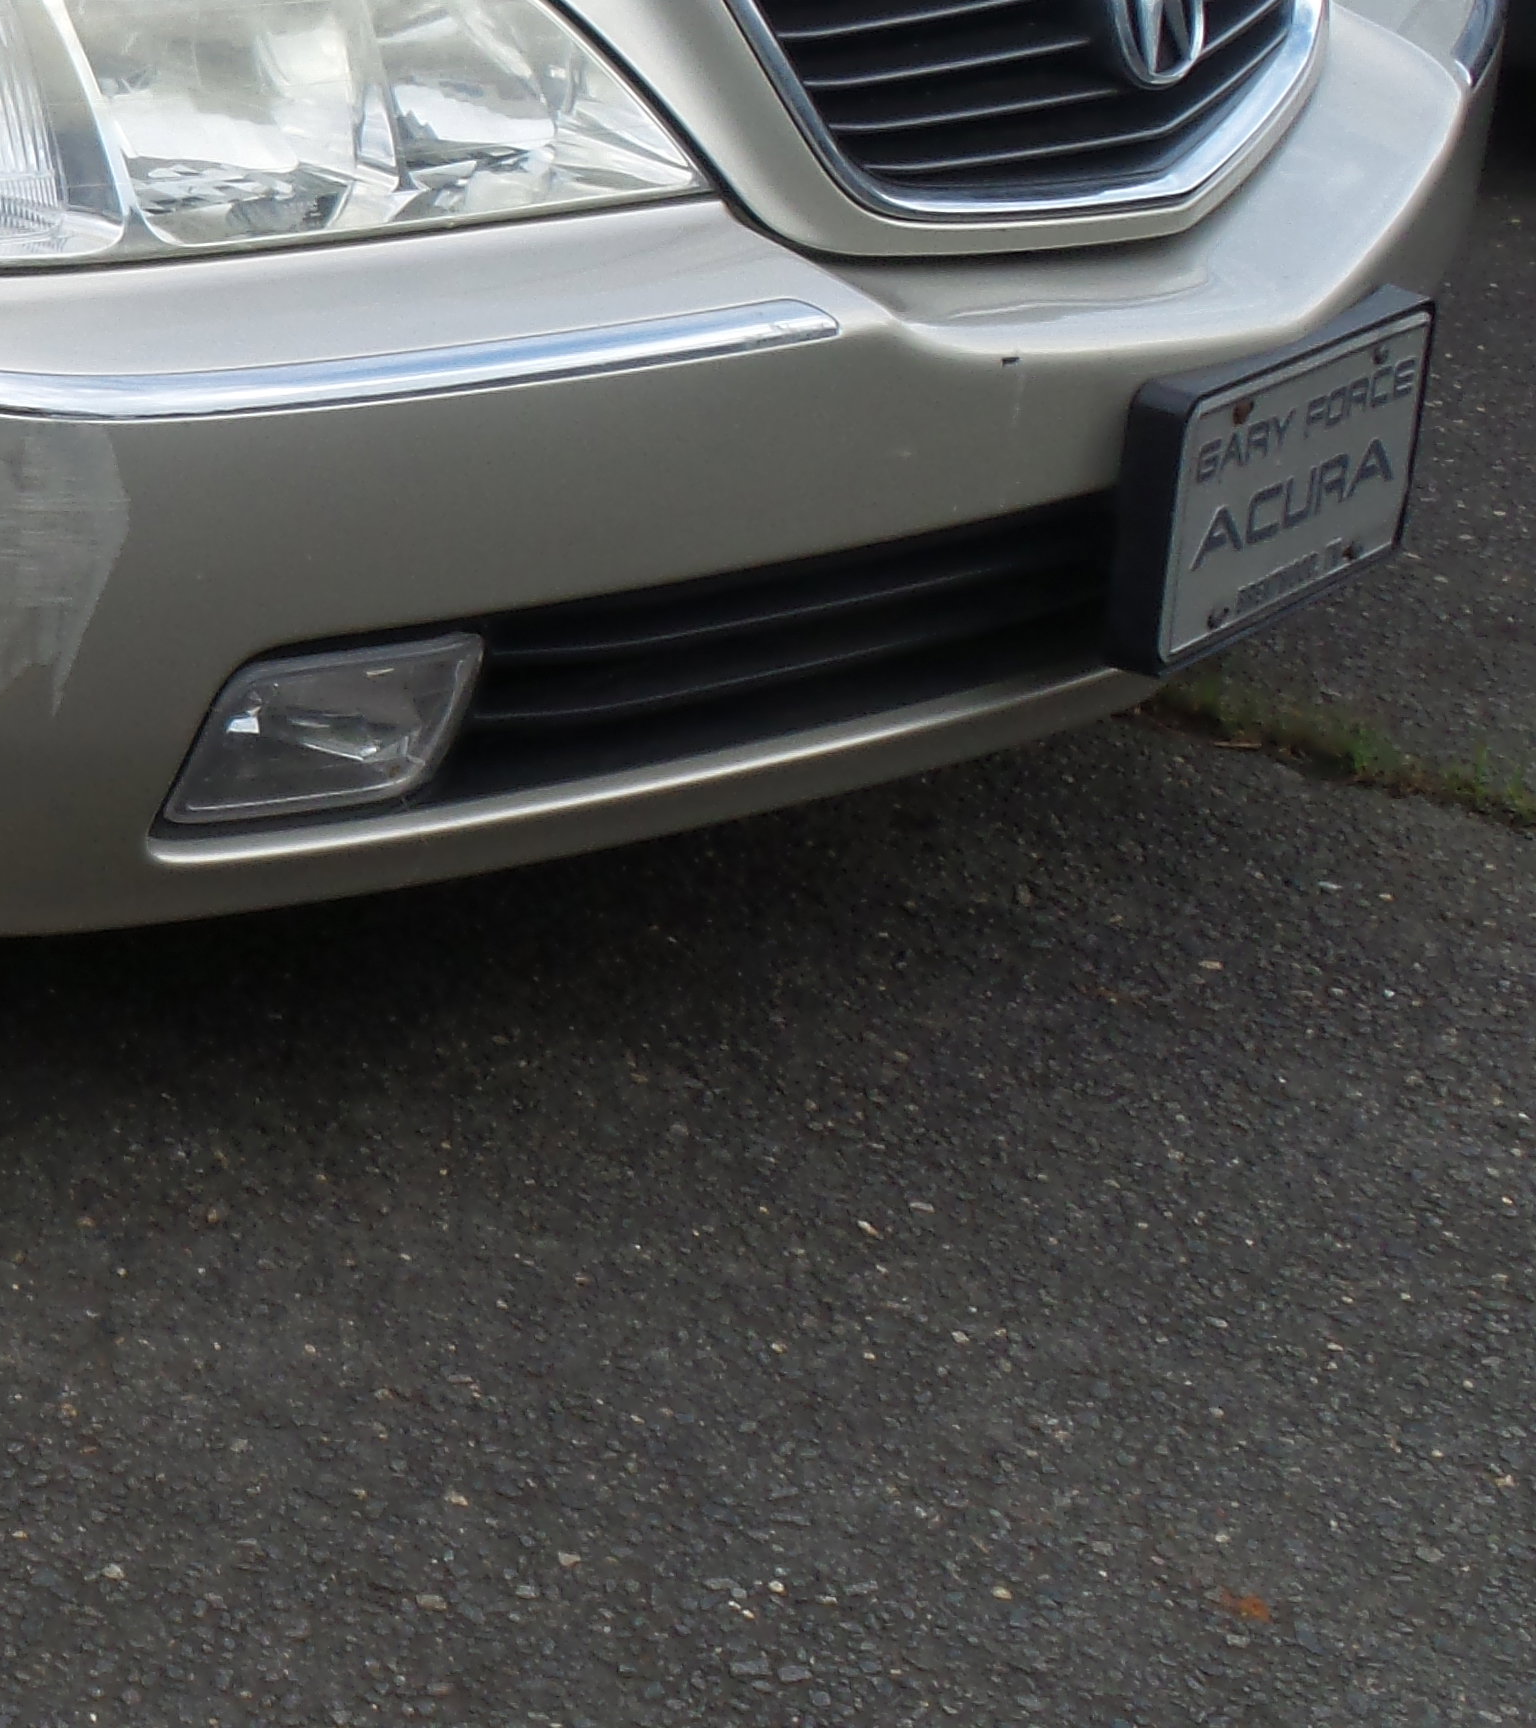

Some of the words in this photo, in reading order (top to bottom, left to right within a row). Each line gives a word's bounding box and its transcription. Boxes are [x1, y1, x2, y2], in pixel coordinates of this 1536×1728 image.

[1195, 408, 1296, 485] GARY
[1303, 356, 1417, 438] FORCE
[1189, 437, 1395, 572] ACURA
